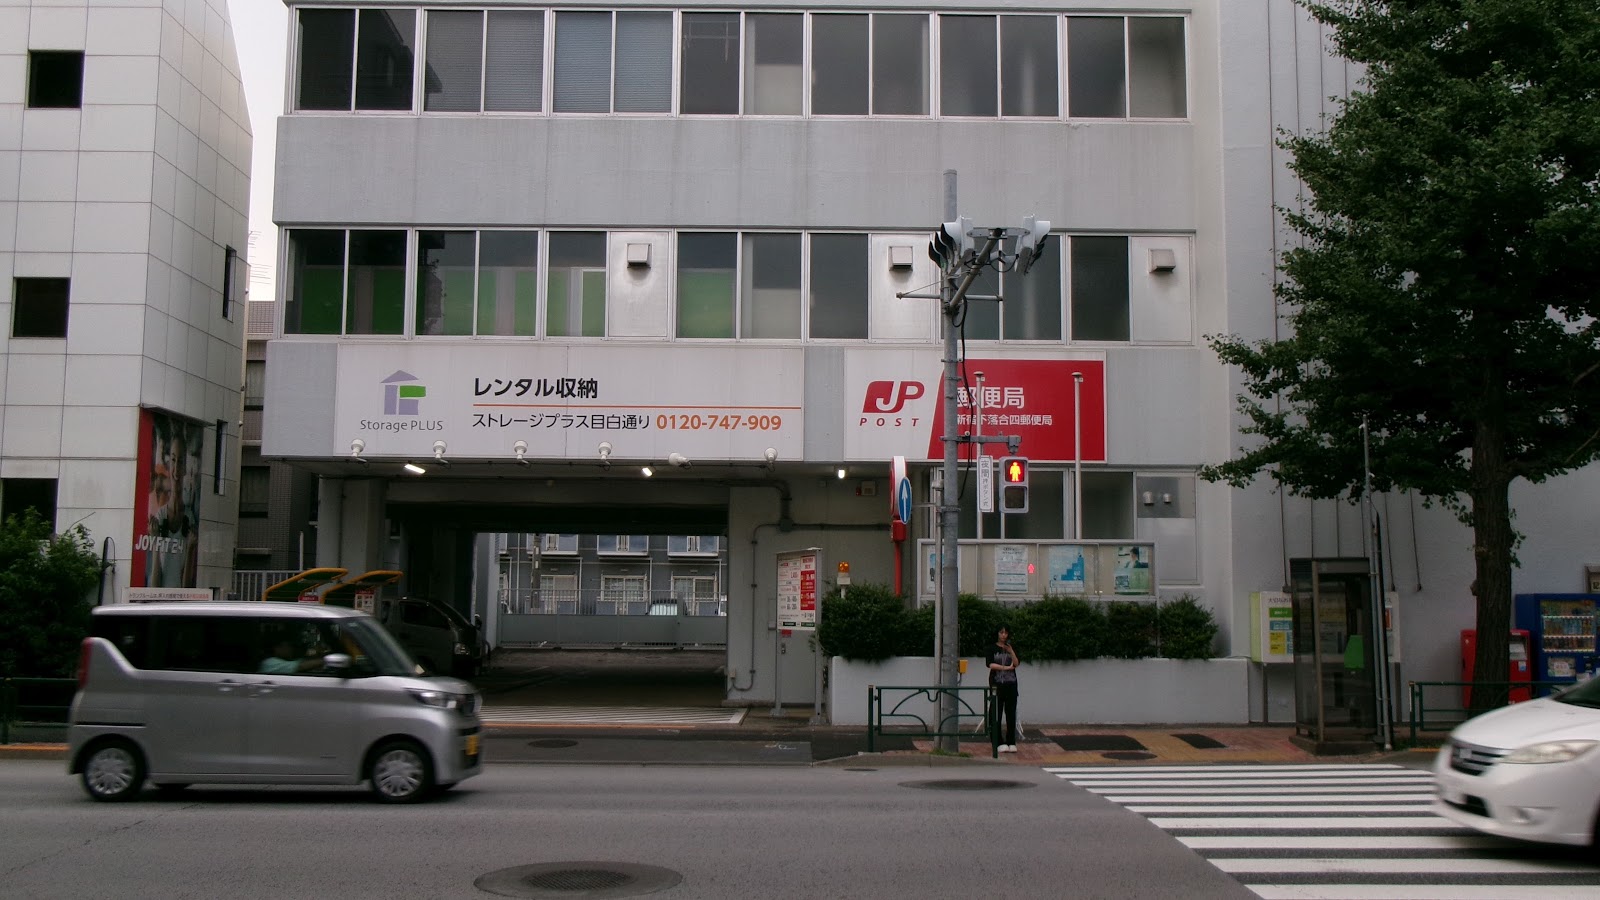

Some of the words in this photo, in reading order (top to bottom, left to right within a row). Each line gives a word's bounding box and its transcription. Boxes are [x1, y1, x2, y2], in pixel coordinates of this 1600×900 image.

[474, 377, 598, 399] レンタル収納
[862, 380, 925, 413] JP
[957, 386, 1024, 408] 郵便局
[360, 419, 408, 434] Storage
[410, 420, 444, 431] PLUS
[472, 412, 650, 430] ストレージプラス目白通り
[656, 414, 782, 431] 0120-747-909
[859, 417, 919, 427] POST
